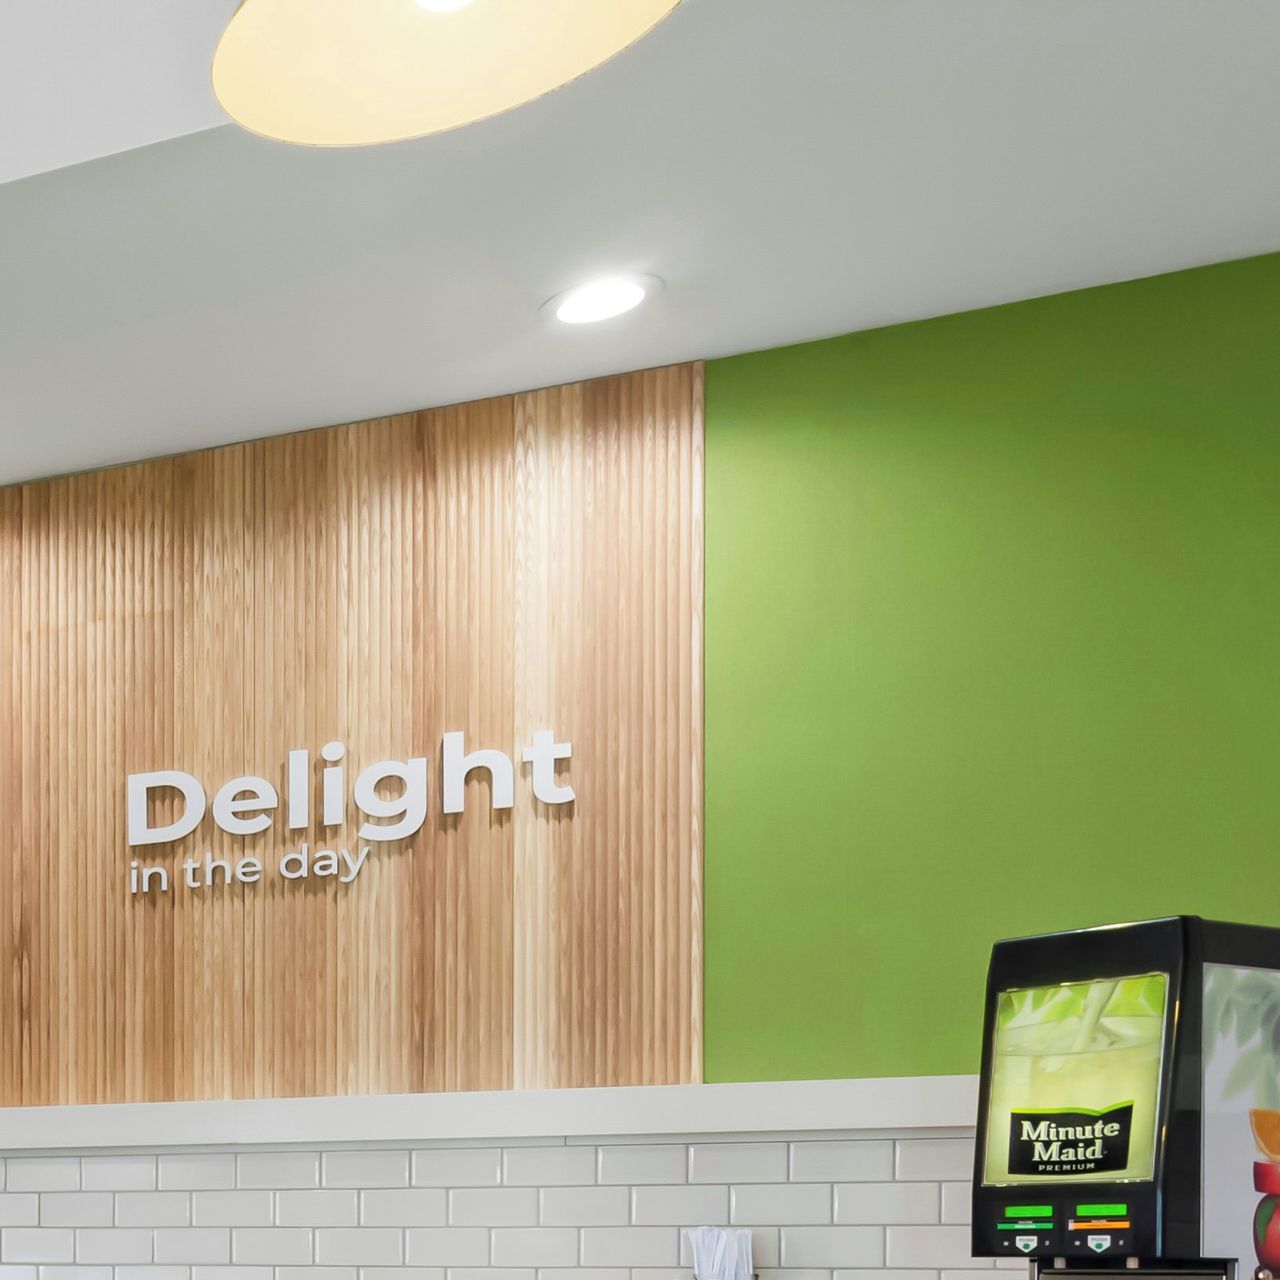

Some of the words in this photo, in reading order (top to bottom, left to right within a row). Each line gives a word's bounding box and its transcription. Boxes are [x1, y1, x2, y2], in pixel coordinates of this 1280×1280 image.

[127, 730, 576, 846] Delight
[130, 861, 168, 894] in
[183, 852, 263, 889] the
[279, 842, 370, 883] day
[1020, 1120, 1120, 1141] Minute
[1032, 1139, 1103, 1161] Maid
[1038, 1163, 1095, 1171] PREMIUM
